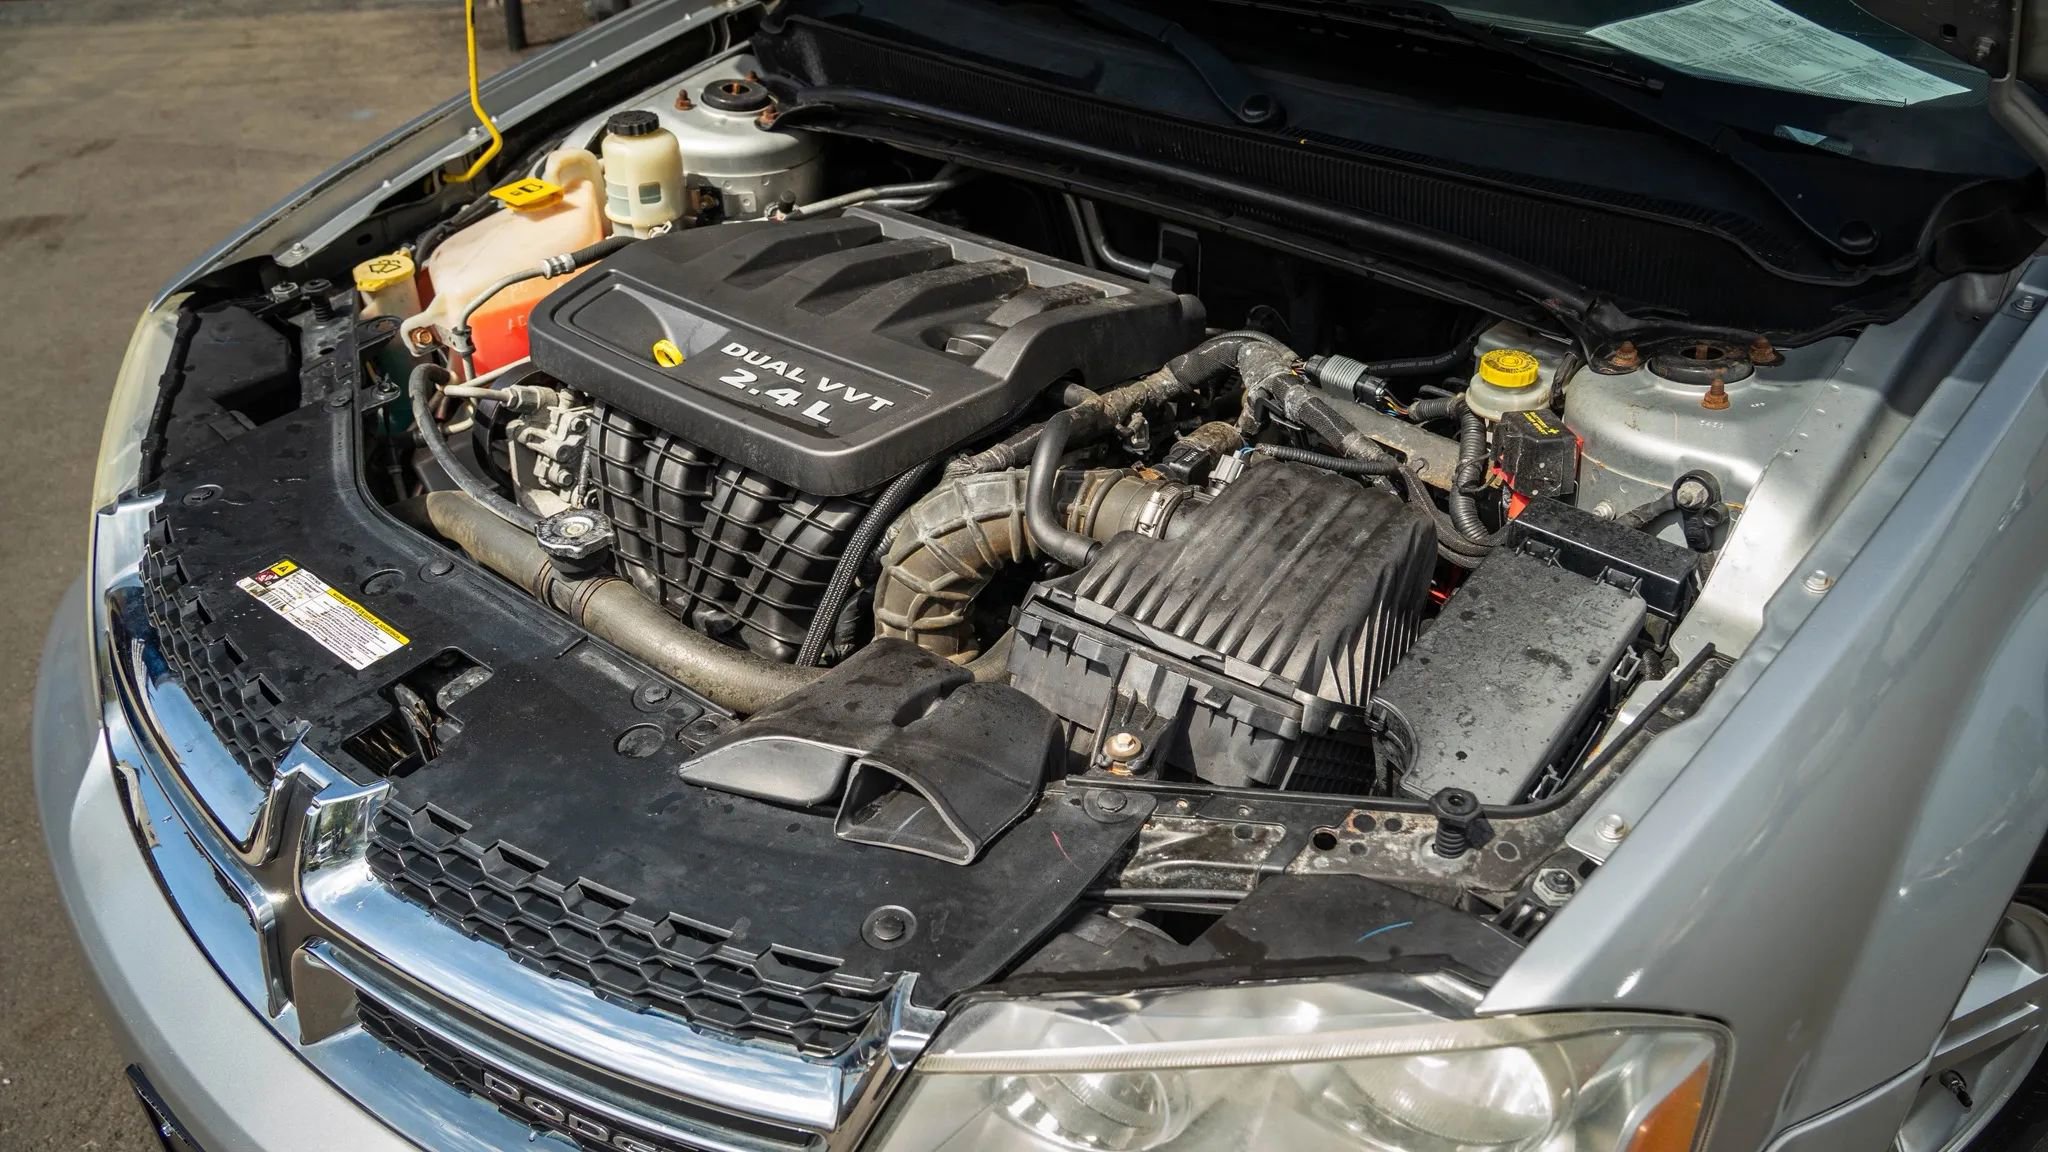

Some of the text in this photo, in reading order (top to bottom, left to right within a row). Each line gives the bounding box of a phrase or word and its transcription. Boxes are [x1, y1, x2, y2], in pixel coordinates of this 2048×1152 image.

[718, 368, 832, 425] 2.4 L
[720, 342, 896, 412] DUAL VVT
[484, 1072, 672, 1152] DODG
